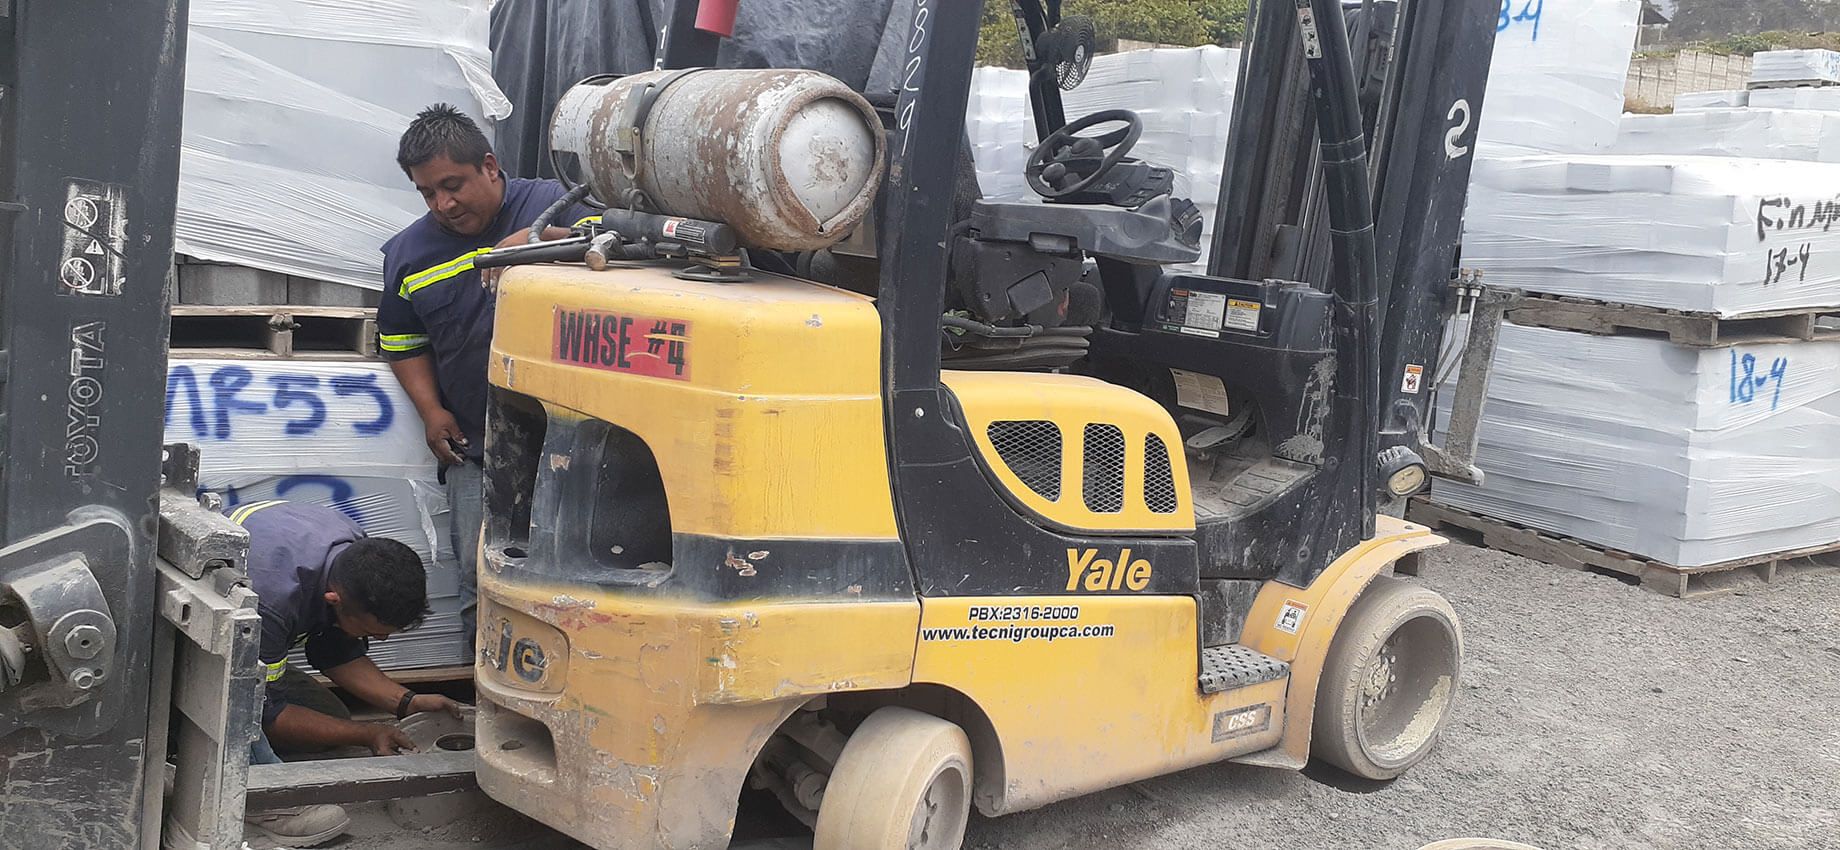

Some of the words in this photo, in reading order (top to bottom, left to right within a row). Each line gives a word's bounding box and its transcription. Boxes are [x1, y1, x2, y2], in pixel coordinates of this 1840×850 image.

[560, 309, 633, 369] WHSE
[1729, 348, 1788, 411] 18-4
[1065, 548, 1153, 592] Yale
[968, 606, 1079, 621] PBX:2316-2000
[922, 624, 1114, 642] www.tecnigroupca.com
[1228, 710, 1257, 730] CSS
